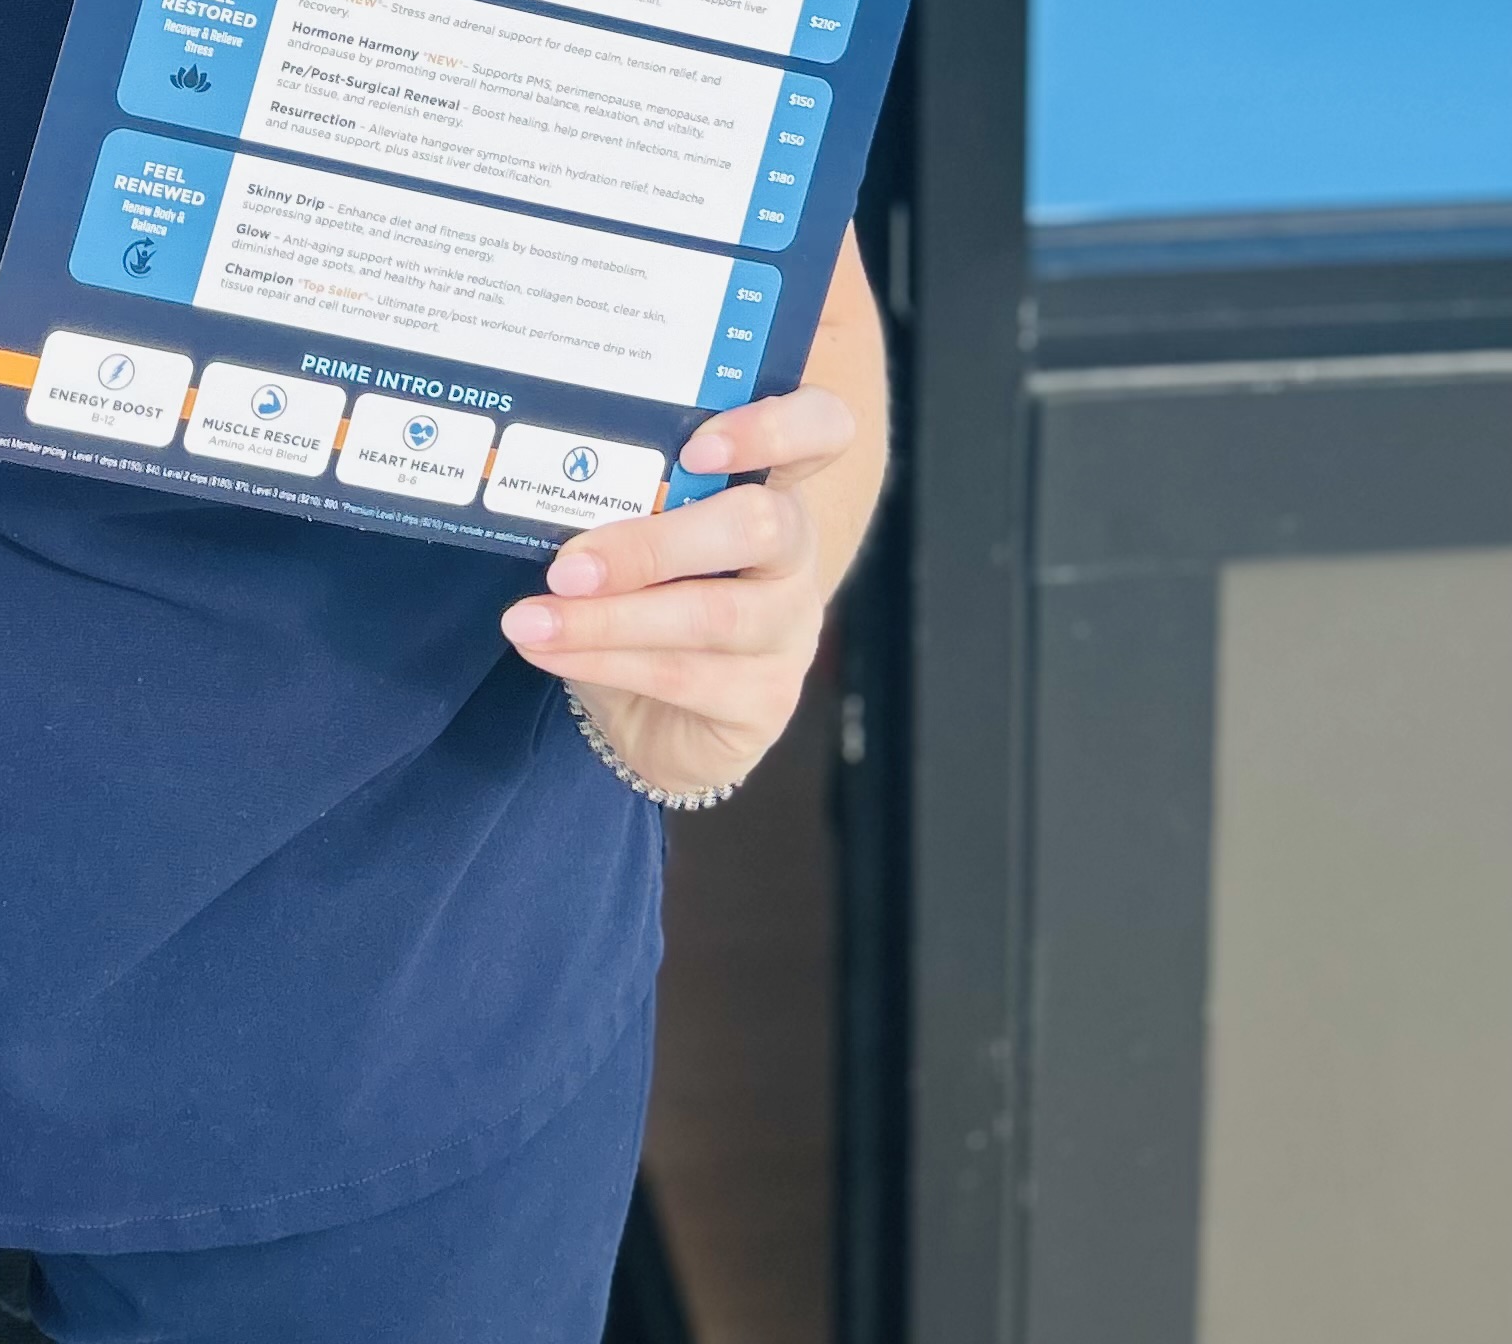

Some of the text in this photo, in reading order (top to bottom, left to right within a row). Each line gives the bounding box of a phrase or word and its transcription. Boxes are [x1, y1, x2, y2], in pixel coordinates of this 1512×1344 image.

[183, 39, 214, 57] Stress
[290, 19, 420, 62] Hormone Harmony
[268, 99, 356, 130] Resurrection
[279, 59, 732, 170] Pre/Post-Surgical Renewal Boost healing, help prevent infections, minimize
[788, 92, 815, 108] $150
[778, 130, 805, 146] $150
[142, 161, 185, 183] FEEL
[113, 174, 205, 206] RENEWED
[245, 182, 326, 212] Skinny Drip
[235, 222, 272, 240] Glow
[223, 261, 294, 287] Champion
[219, 277, 439, 332] tissue repair and cell turnover support.
[735, 287, 762, 302] $150
[300, 353, 513, 412] PRIME INTRO DRIPS
[47, 386, 164, 420] ENERGY BOOST
[201, 416, 321, 451] MUSCLE RESCUE
[207, 434, 308, 463] Amino Acid Blend
[357, 447, 465, 480] HEART HEALTH
[496, 475, 643, 514] ANTI-INFLAMMATION
[534, 498, 596, 519] Magnesium
